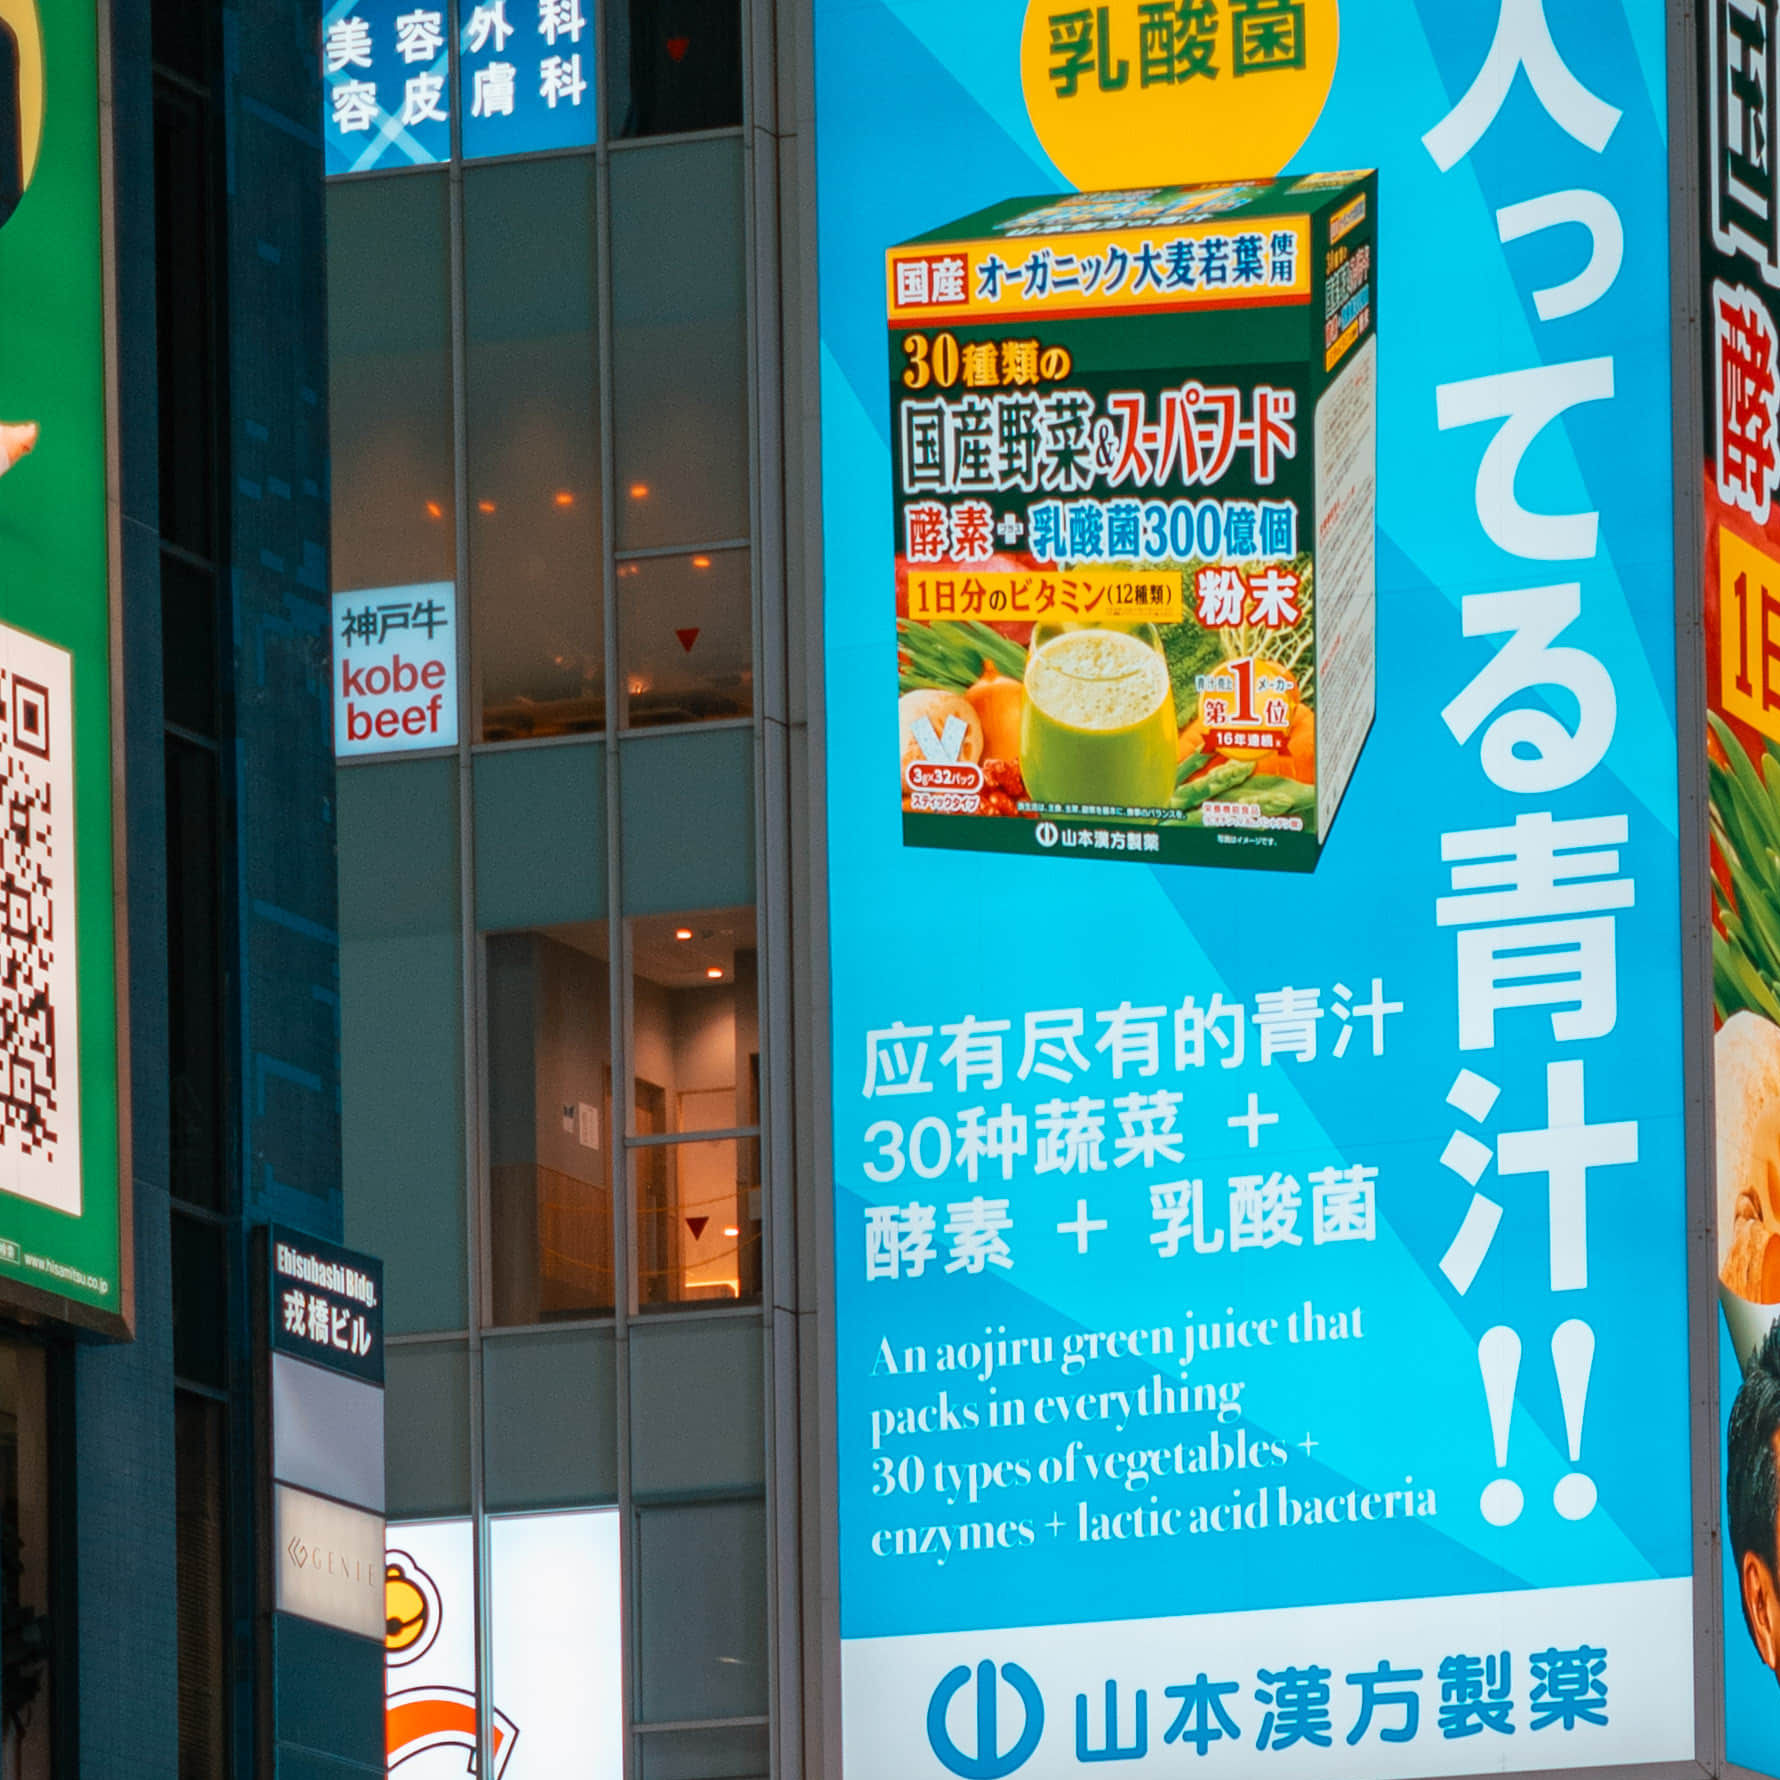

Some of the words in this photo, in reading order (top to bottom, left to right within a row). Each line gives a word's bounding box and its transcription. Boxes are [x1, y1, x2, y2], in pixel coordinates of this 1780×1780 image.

[327, 0, 587, 71] 美容外科
[1049, 0, 1306, 98] 乳酸菌
[896, 259, 967, 305] 国産
[977, 234, 1266, 299] オーガニック大麦若葉
[1268, 232, 1297, 285] 使用
[903, 333, 1072, 390] 30種類の
[1027, 498, 1299, 563] 乳酸菌300億個
[341, 599, 448, 649] 神戸牛
[916, 578, 1173, 615] 1日分のビタミン(12種類)
[1196, 566, 1301, 628] 粉末
[342, 655, 447, 698] kobe
[347, 696, 443, 742] beef
[1061, 829, 1160, 851] 山本漢方製薬
[862, 977, 1404, 1100] 应有尽有的青汁
[862, 1090, 1186, 1184] 30种蔬菜
[864, 1196, 1014, 1282] 酵素
[1149, 1164, 1380, 1261] 乳酸菌
[23, 1251, 109, 1295] www.hisamitsu.co.jp
[276, 1243, 344, 1295] Ebisubashi
[344, 1267, 378, 1308] Bldg.
[282, 1288, 373, 1358] 戎橋ビル
[869, 1335, 927, 1377] An
[936, 1325, 1055, 1381] aojiru
[1063, 1327, 1174, 1380] green
[1178, 1306, 1278, 1368] juice
[1286, 1301, 1365, 1343] that
[869, 1395, 980, 1450] packs
[988, 1391, 1026, 1430] in
[1034, 1372, 1246, 1431] everything
[871, 1454, 925, 1497] 30
[934, 1452, 1031, 1505] types
[1038, 1440, 1086, 1485] of
[1085, 1430, 1288, 1488] vegetables
[870, 1515, 1036, 1568] enzymes
[1076, 1497, 1181, 1543] lactic
[1188, 1491, 1270, 1535] acid
[1278, 1474, 1439, 1528] bacteria
[312, 1547, 377, 1588] GENIE
[1074, 1645, 1610, 1764] 山本漢方製薬
